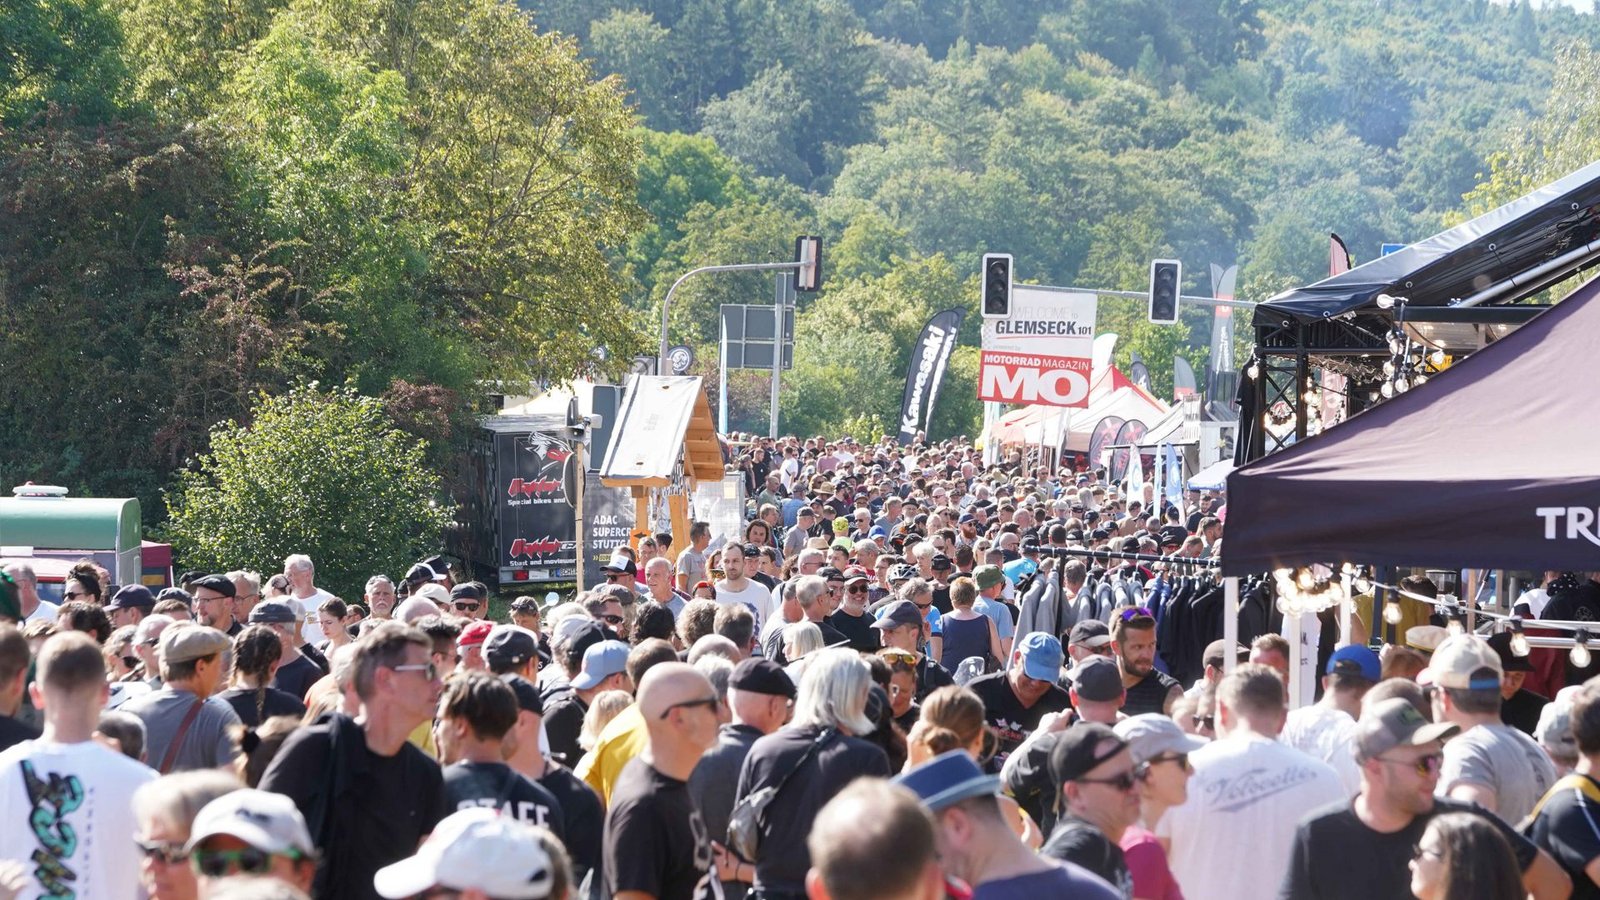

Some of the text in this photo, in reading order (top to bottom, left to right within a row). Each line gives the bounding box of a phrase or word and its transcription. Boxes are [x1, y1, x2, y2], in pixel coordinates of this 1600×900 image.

[1013, 306, 1071, 319] WELCOME
[995, 320, 1092, 335] GLEMSECK 101
[984, 354, 1089, 371] MOTORRAD MAGAZIN
[900, 324, 946, 435] Kawasaki
[981, 364, 1090, 405] MO
[593, 515, 618, 525] ADAC
